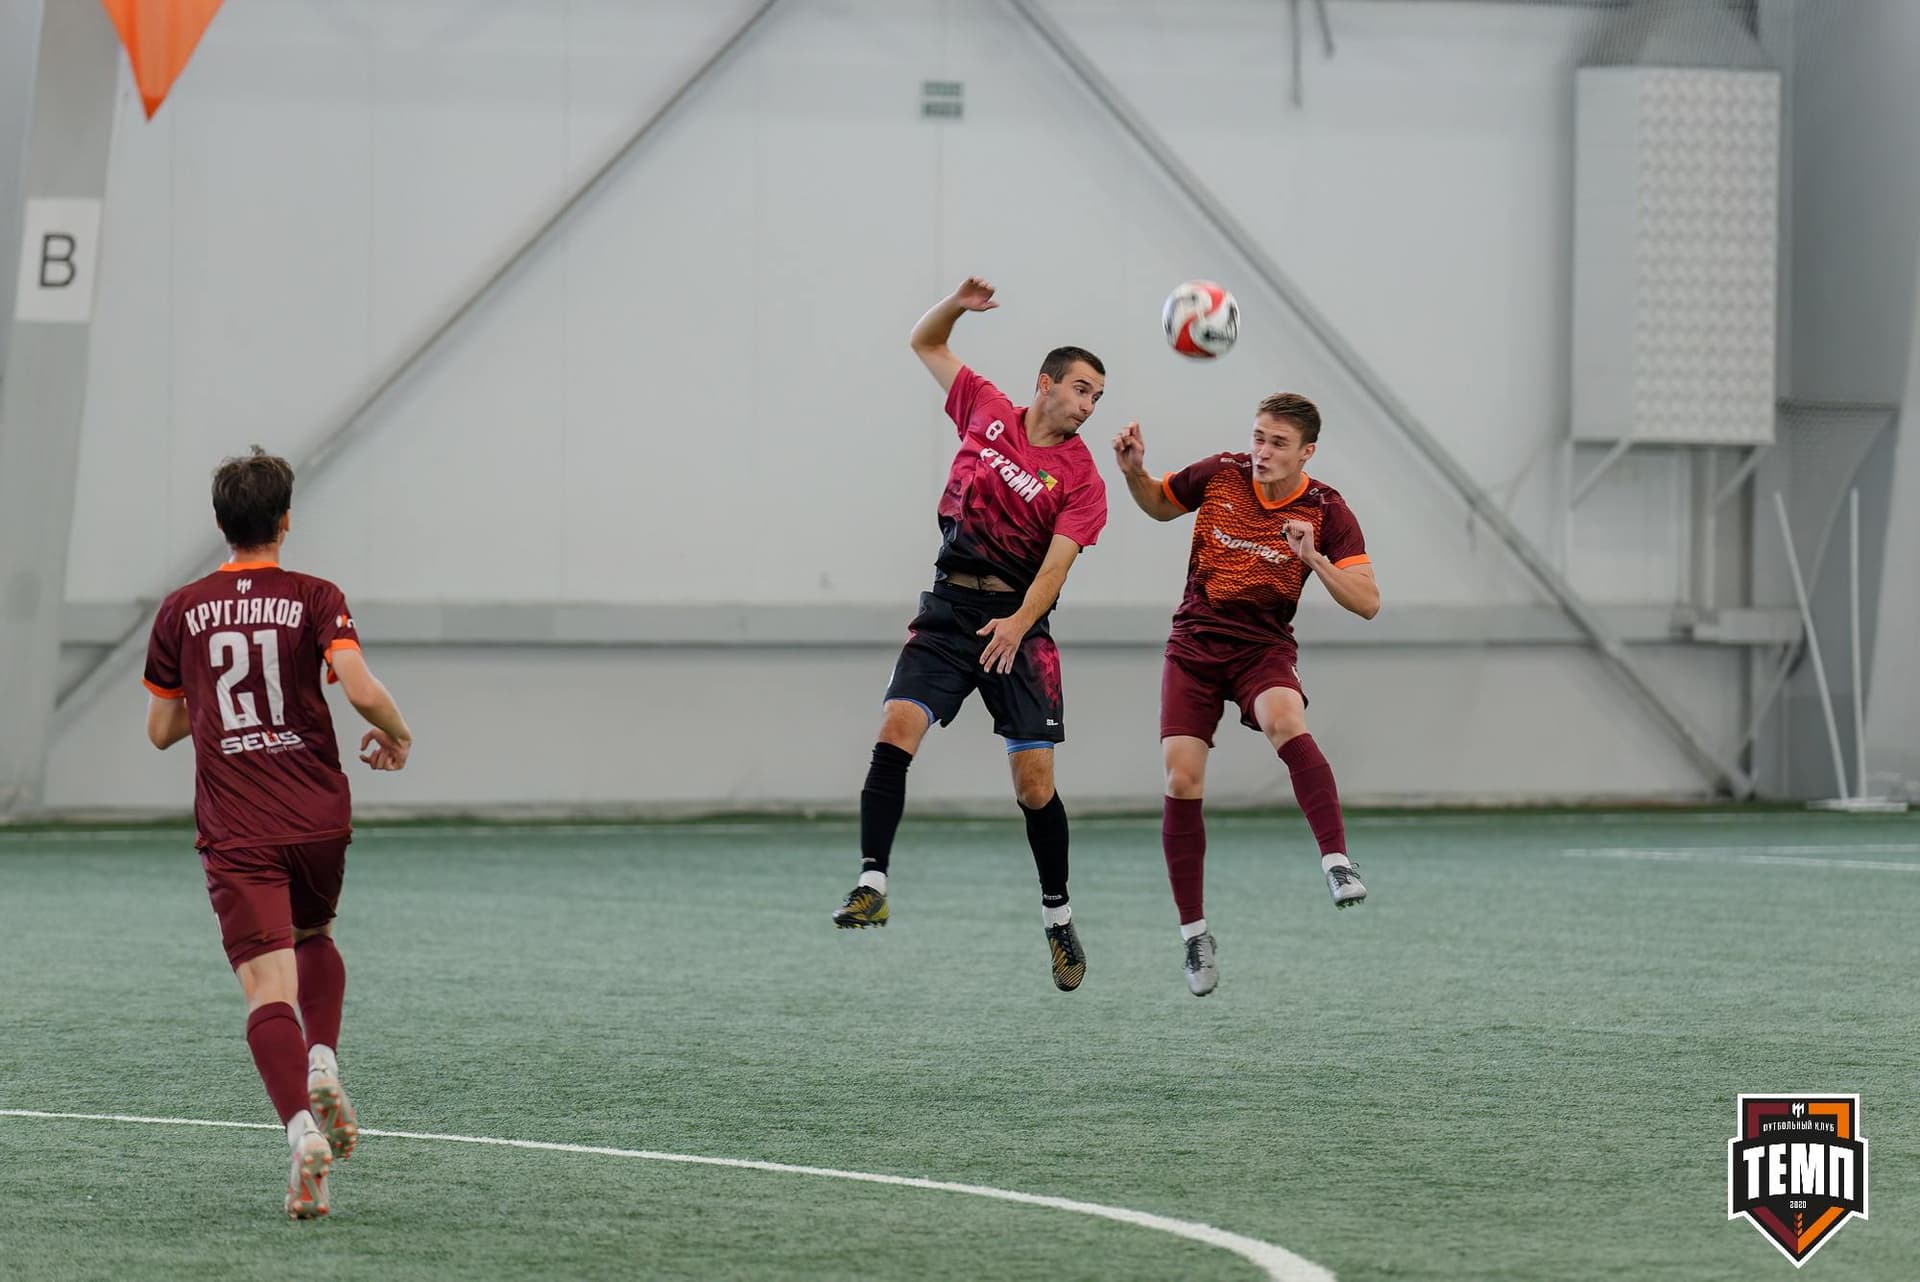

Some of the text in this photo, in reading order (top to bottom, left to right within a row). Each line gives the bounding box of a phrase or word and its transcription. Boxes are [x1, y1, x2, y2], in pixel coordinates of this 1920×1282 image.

[985, 419, 1005, 442] 8
[184, 597, 304, 637] КРУГЛЯКОВ
[208, 628, 286, 731] 21
